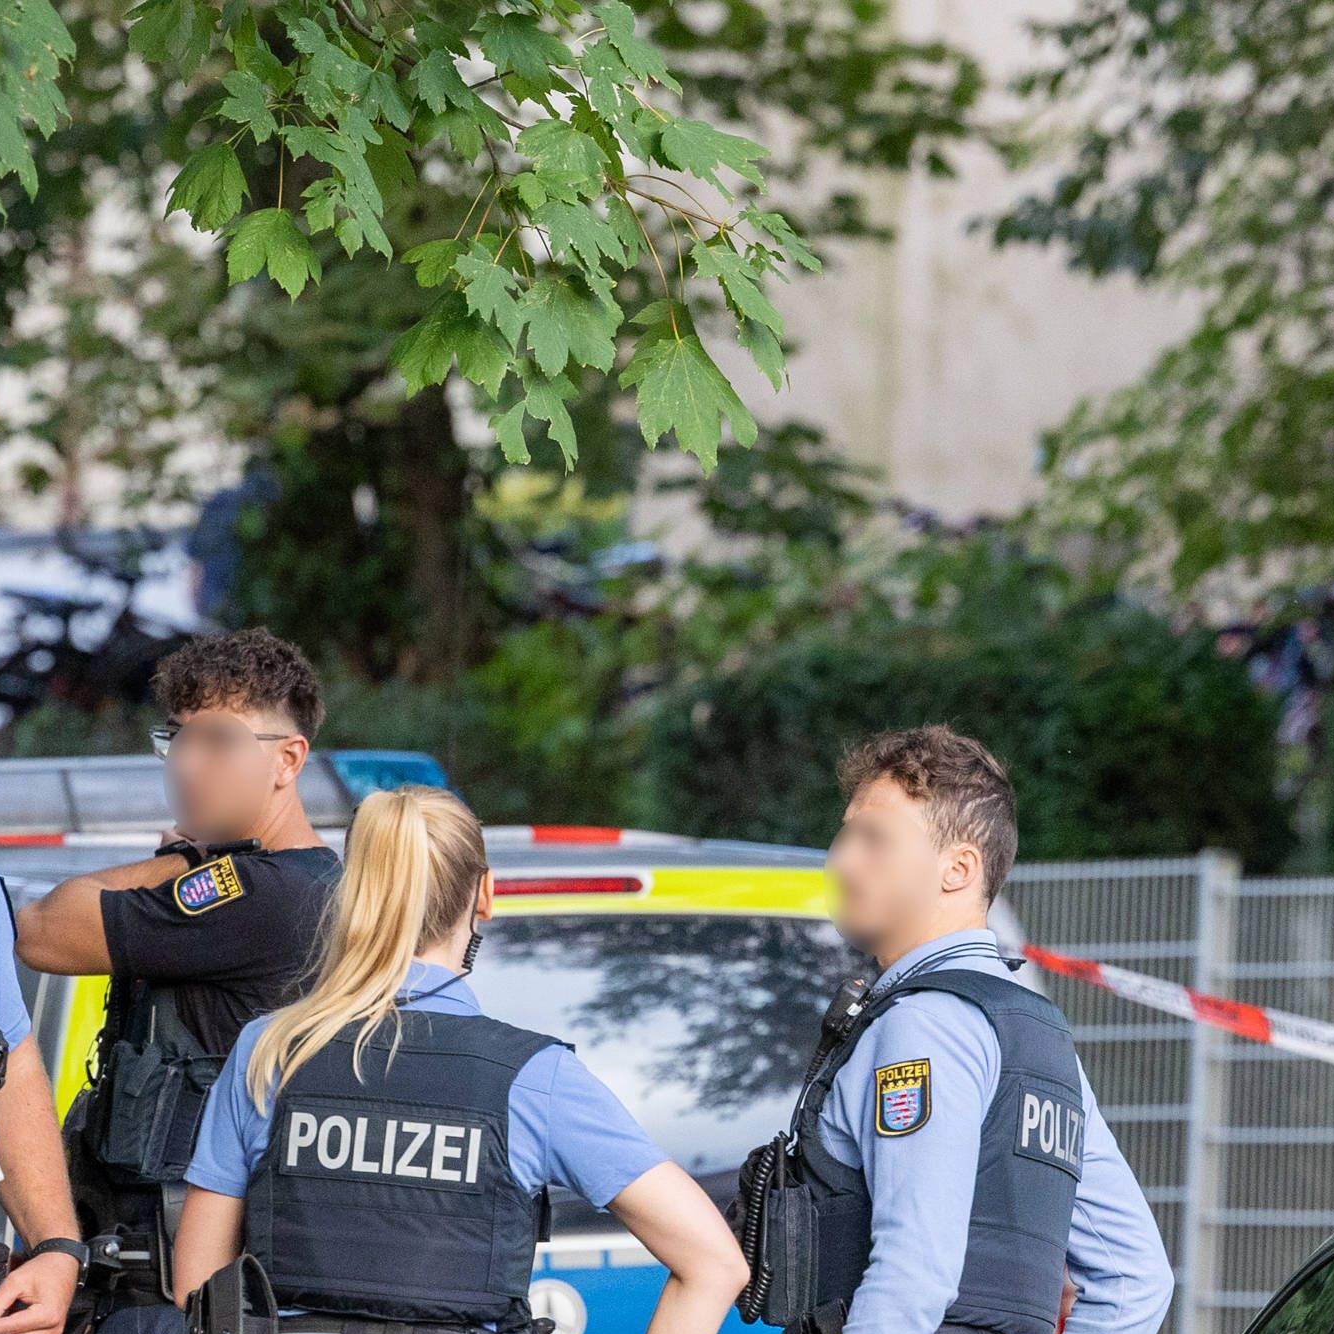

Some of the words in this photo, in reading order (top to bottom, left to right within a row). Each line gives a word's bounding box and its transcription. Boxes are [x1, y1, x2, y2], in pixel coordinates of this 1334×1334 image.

[219, 858, 241, 898] POLIZEI
[879, 1064, 927, 1081] POLIZEI
[286, 1111, 482, 1184] POLIZEI
[1021, 1093, 1084, 1168] POLIZE
